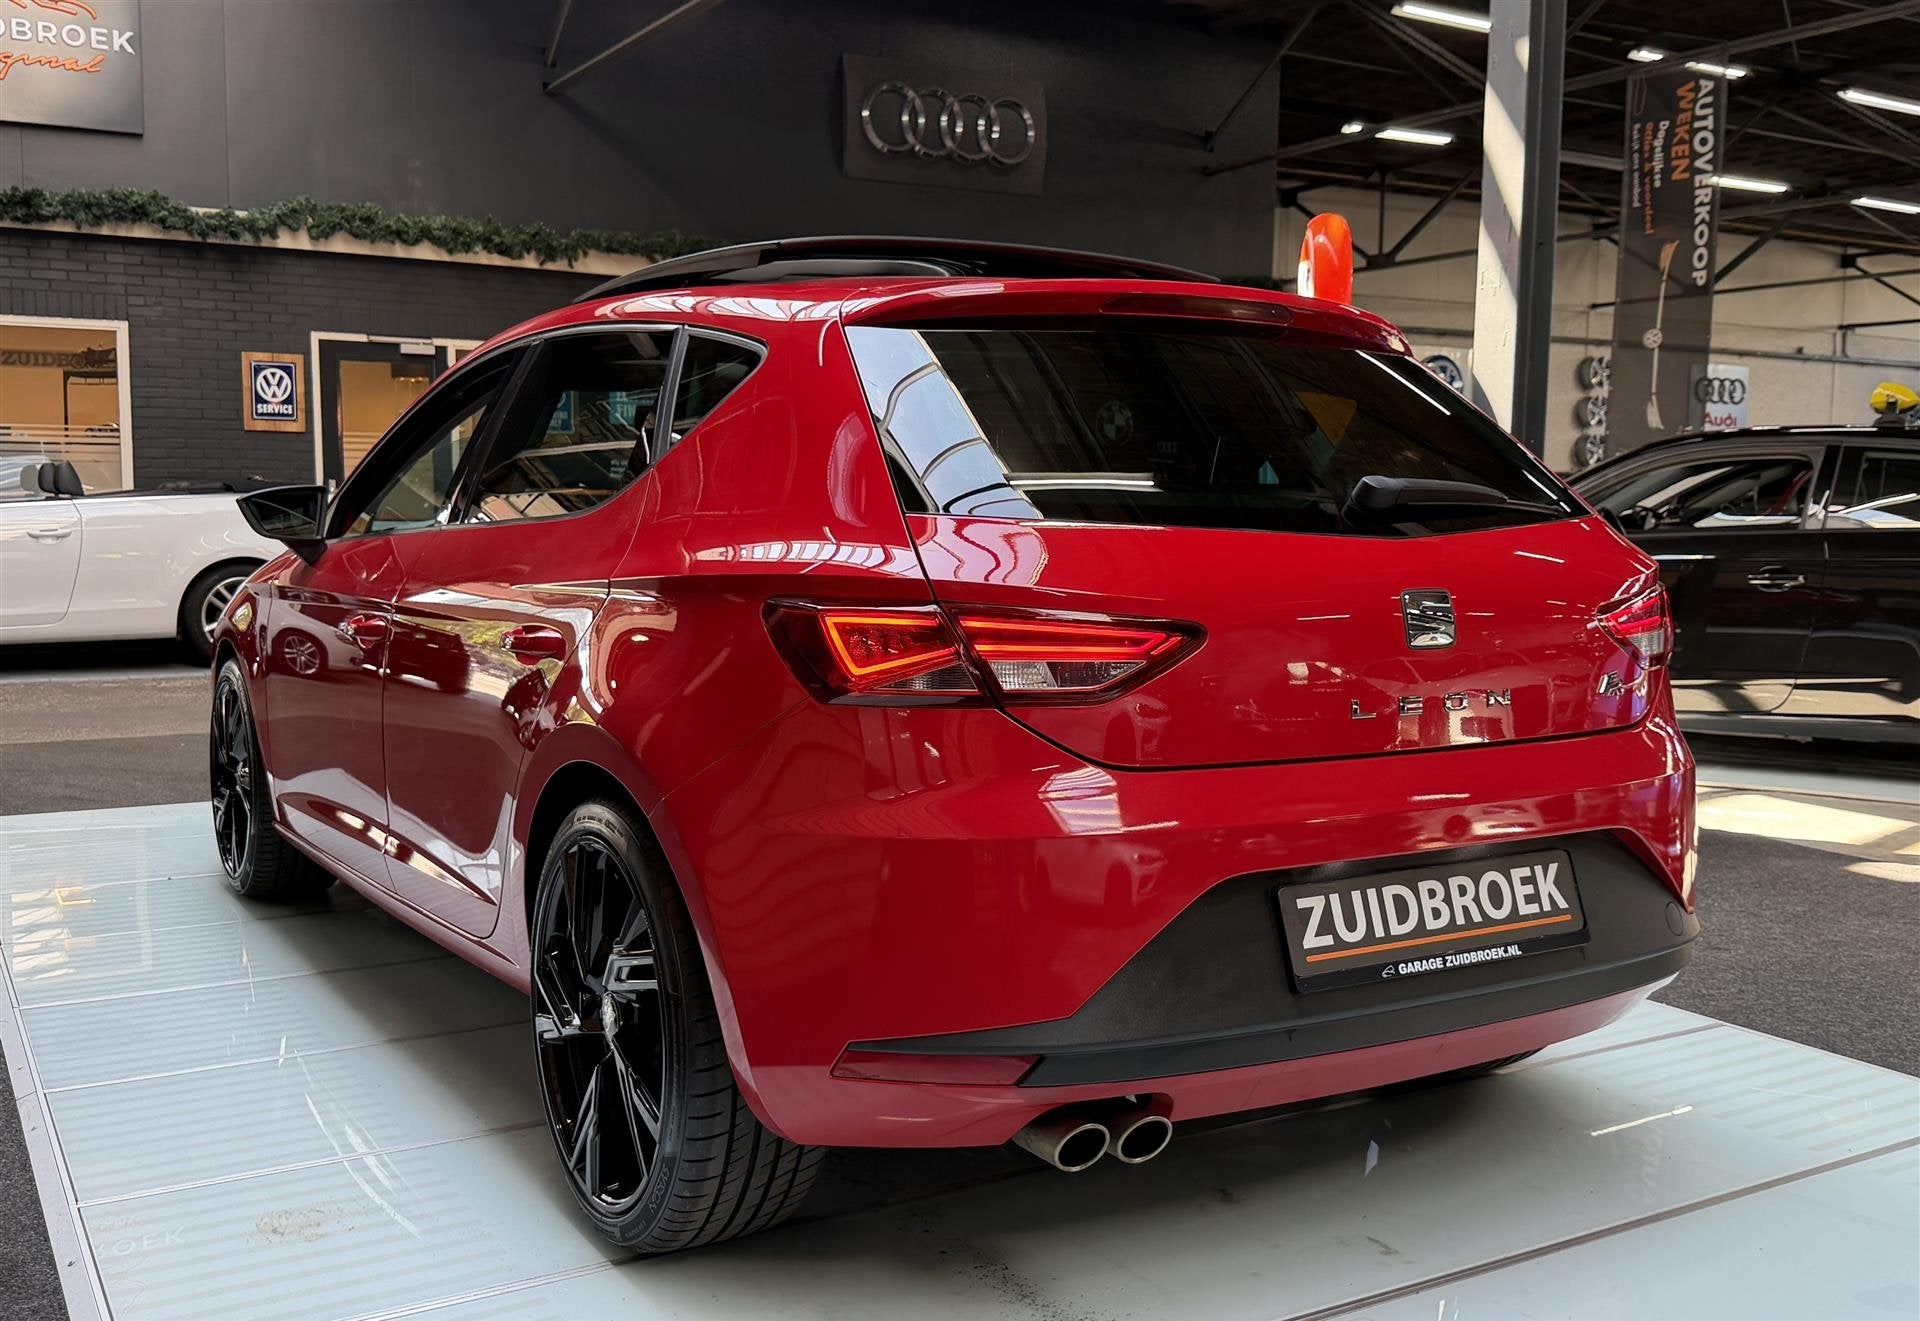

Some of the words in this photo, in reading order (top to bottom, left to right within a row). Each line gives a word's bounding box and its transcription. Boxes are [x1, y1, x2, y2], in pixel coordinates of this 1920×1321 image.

[0, 18, 135, 55] BROEK
[1671, 80, 1696, 181] WEKEN
[1652, 120, 1670, 189] Dagelijkse
[1692, 78, 1715, 286] AUTOVERKOOP
[257, 403, 293, 415] SERVICE
[1704, 412, 1737, 427] Audi
[1351, 688, 1511, 720] LEON
[1296, 863, 1570, 949] ZUIDBROEK
[1398, 957, 1444, 975] GARAGE
[1445, 944, 1523, 968] ZUIDBROEK.NL
